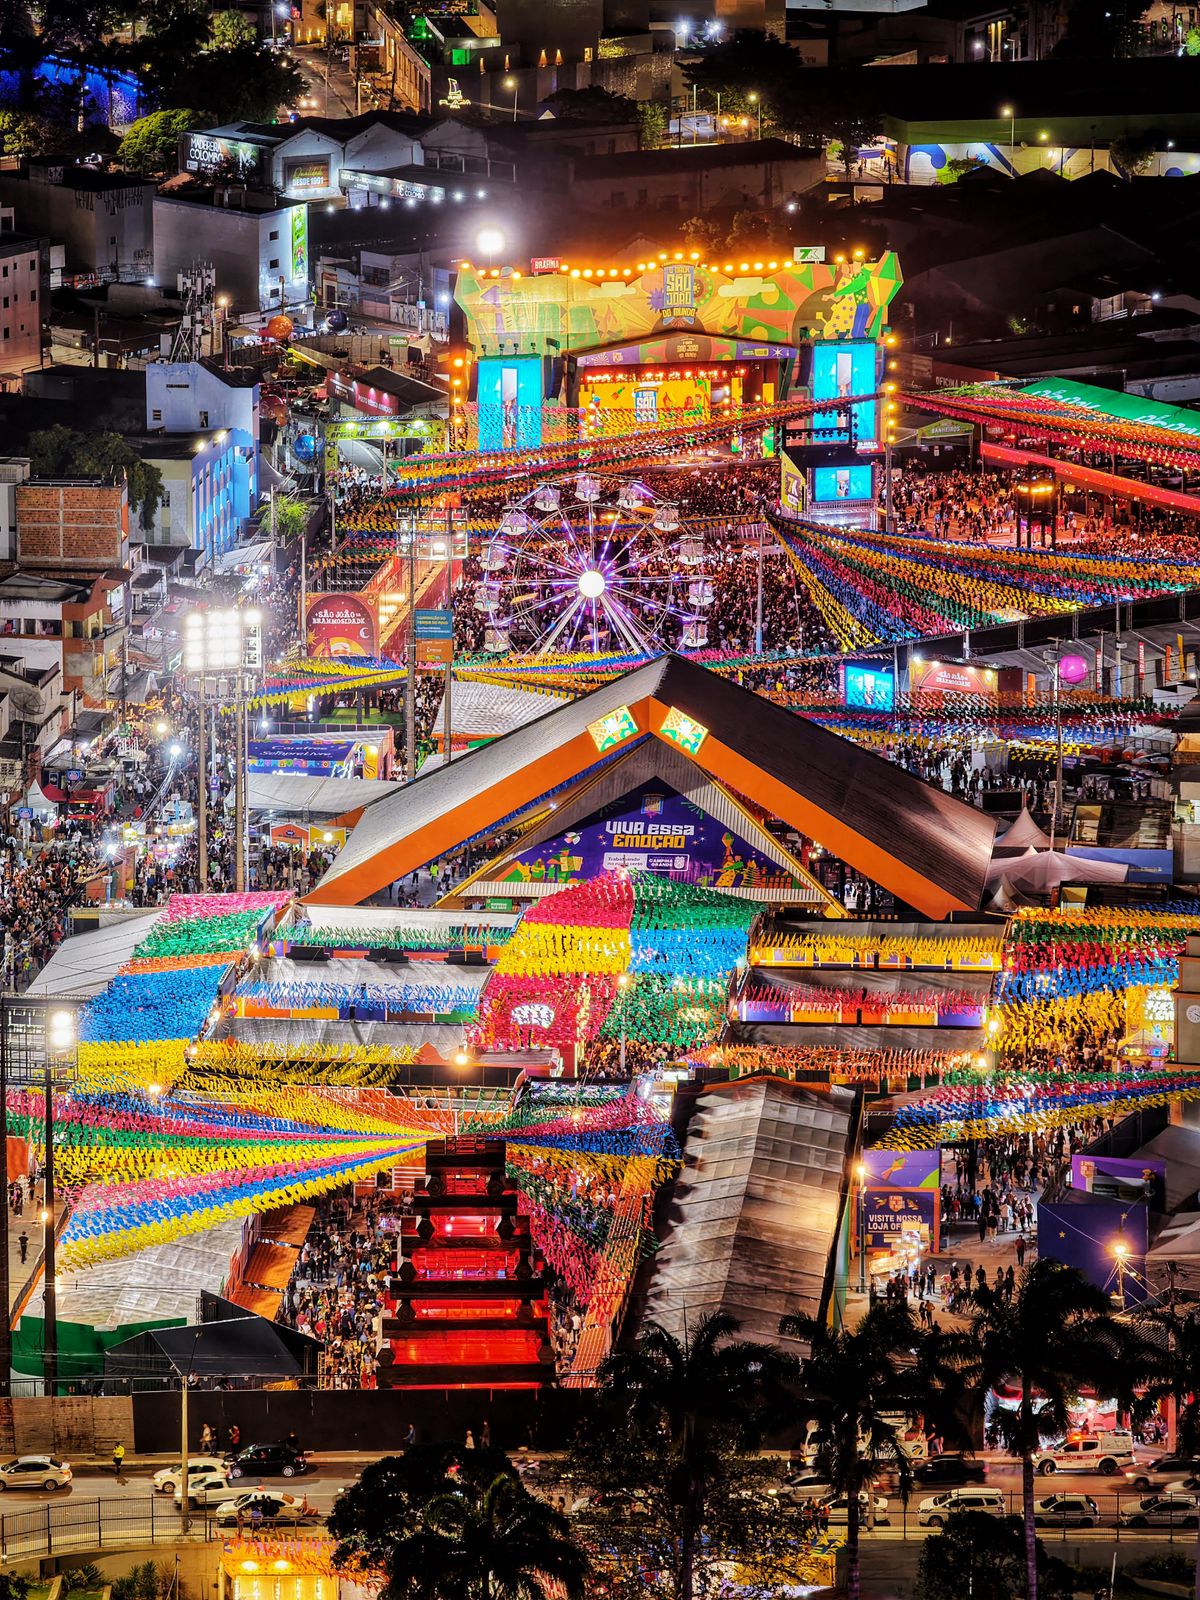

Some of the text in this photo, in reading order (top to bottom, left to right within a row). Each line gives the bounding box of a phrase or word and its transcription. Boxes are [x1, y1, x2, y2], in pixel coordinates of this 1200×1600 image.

[189, 148, 224, 162] COLOMBO
[800, 248, 820, 260] 7K
[534, 260, 560, 269] BRAHMA
[673, 308, 696, 317] MUNDO
[935, 376, 959, 388] OFICINA
[931, 426, 961, 434] BANHEIROS
[318, 609, 335, 618] SÃO
[335, 609, 356, 618] JOÃO
[605, 821, 645, 835] VIVA
[868, 1214, 923, 1223] VISITE NOSSA
[868, 1222, 889, 1231] LOJA
